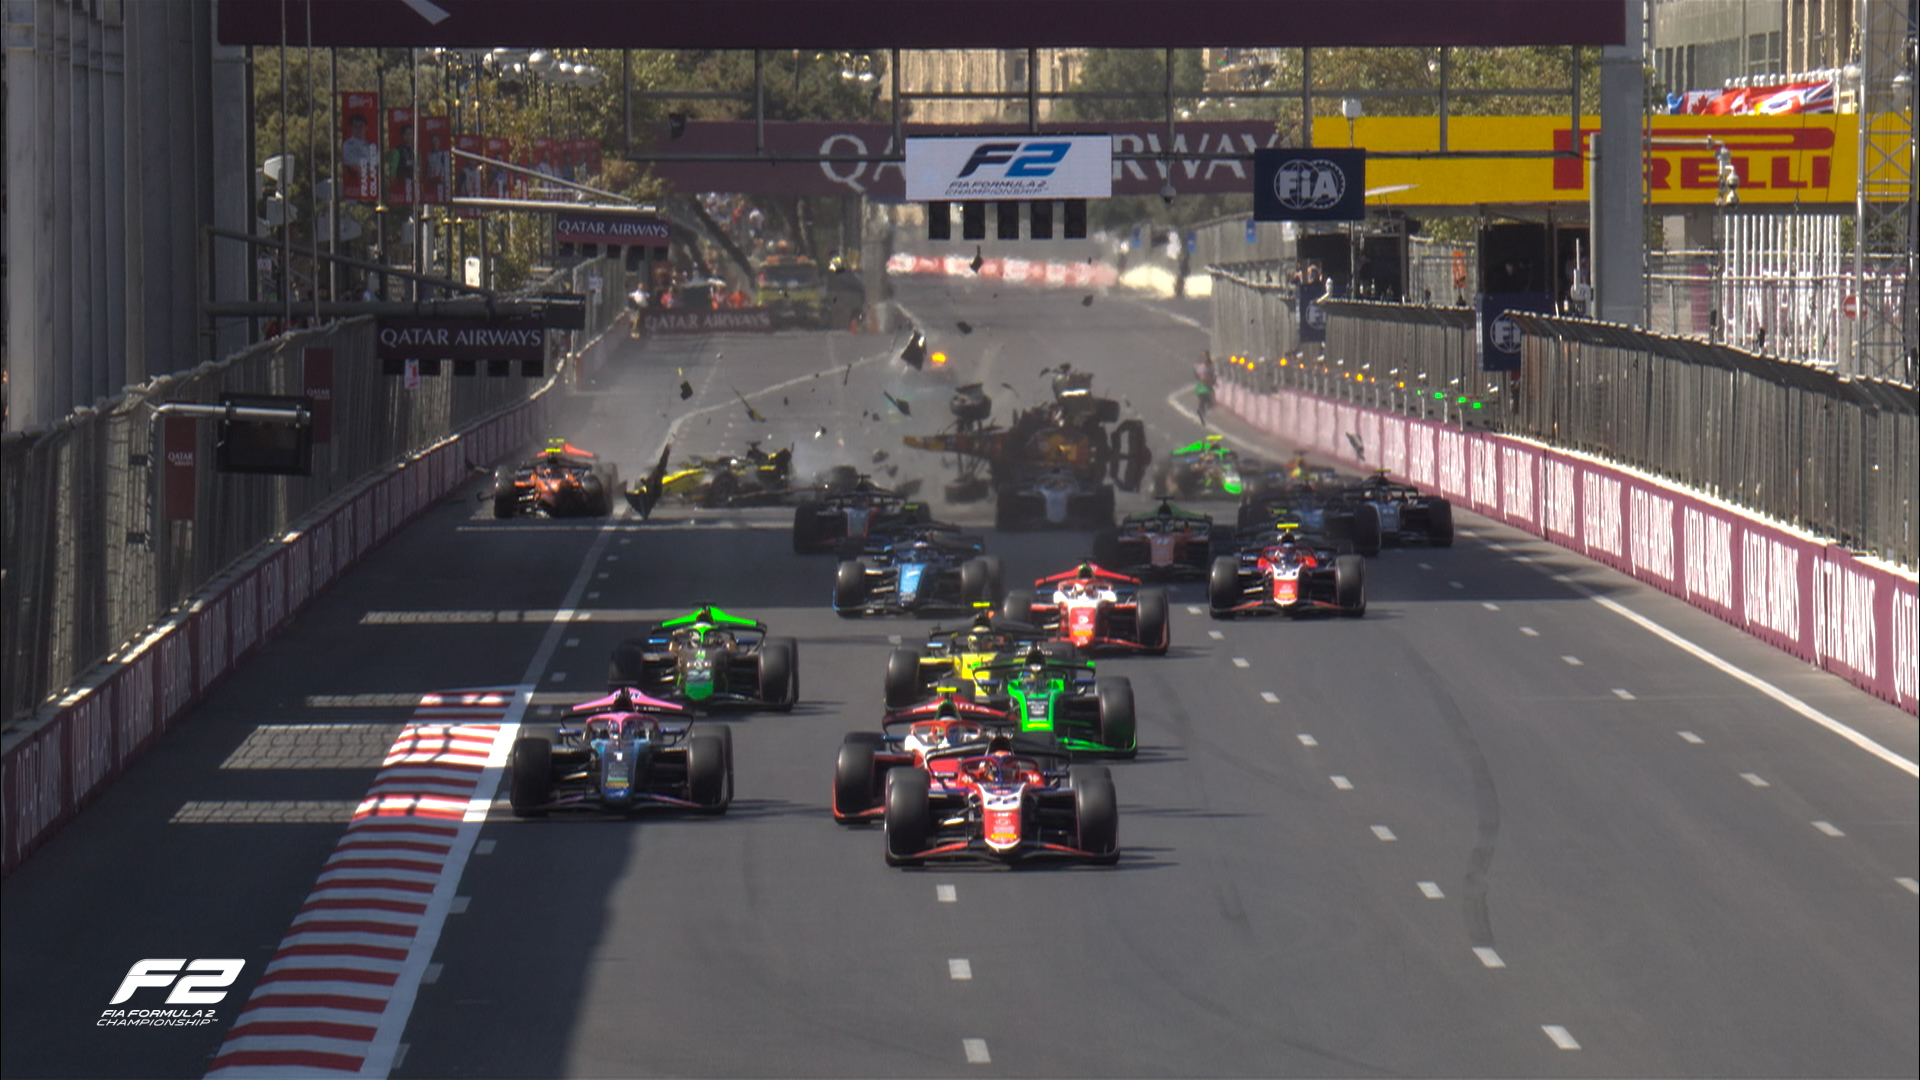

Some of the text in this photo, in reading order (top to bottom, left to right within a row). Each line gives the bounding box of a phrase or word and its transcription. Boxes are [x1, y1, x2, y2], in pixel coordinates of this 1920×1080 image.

[957, 142, 1072, 178] F2
[1553, 127, 1836, 190] PRELLI
[558, 220, 668, 238] QATAR AIRWAYS
[380, 328, 541, 348] QATAR AIRWAYS
[168, 451, 193, 462] QATAR
[1812, 555, 1843, 666] QATAR
